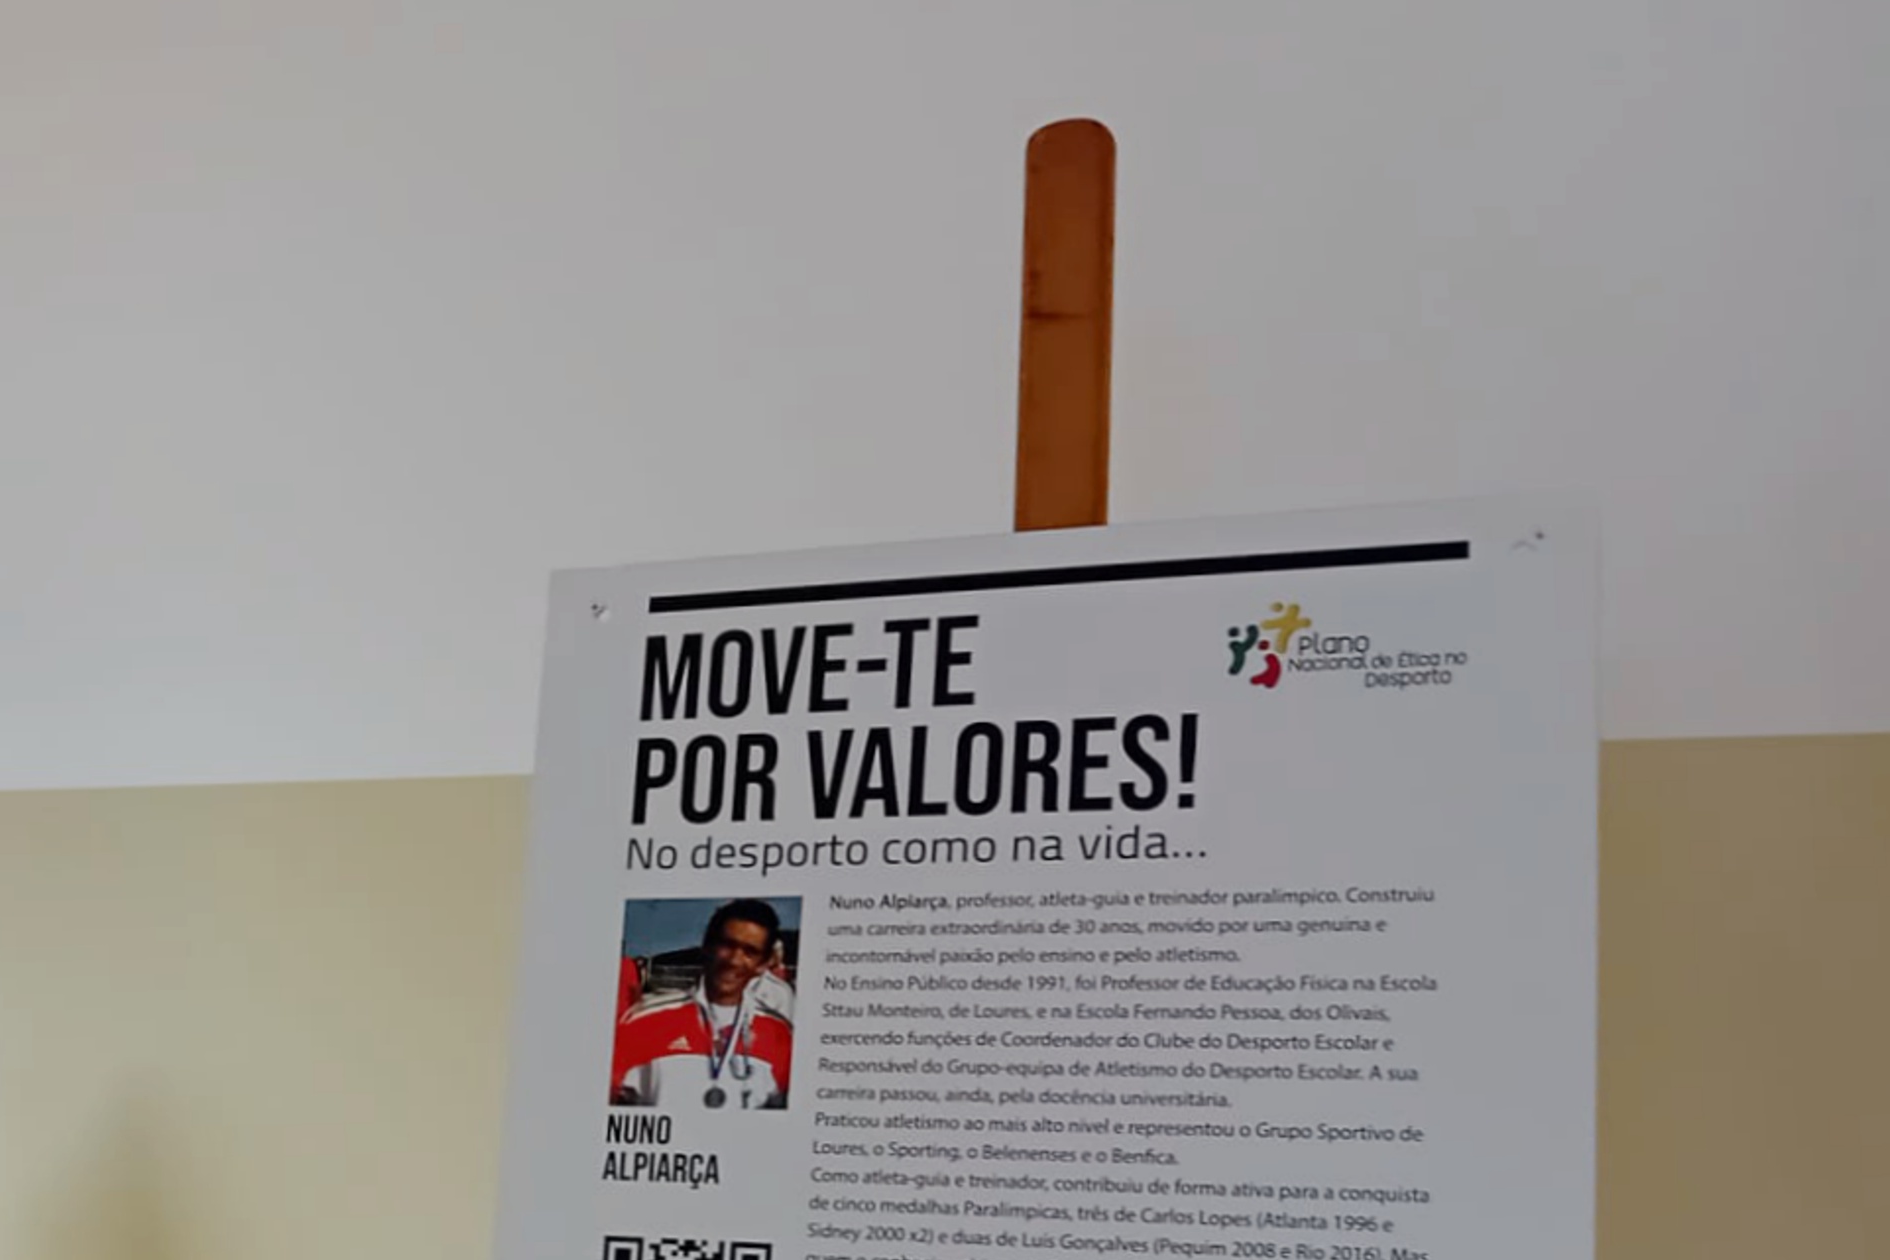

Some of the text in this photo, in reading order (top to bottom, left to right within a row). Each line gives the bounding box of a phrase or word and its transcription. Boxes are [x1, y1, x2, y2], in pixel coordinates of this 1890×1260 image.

[1298, 632, 1370, 656] Plano
[638, 613, 981, 723] MOVE-TE
[1288, 650, 1467, 672] Nacional de Ética no
[1364, 668, 1452, 690] Desporto
[630, 712, 1201, 826] POR VALORES!
[626, 823, 1207, 878] No desporto como na vida...
[828, 894, 876, 911] Nuno
[878, 892, 952, 912] Alpiarça,
[955, 892, 1035, 912] professor,
[1038, 890, 1131, 911] atleta-guia
[1133, 893, 1145, 907] e
[1148, 889, 1229, 907] treinador
[1344, 886, 1435, 904] Construiu
[823, 975, 848, 991] No
[850, 974, 905, 992] Ensino
[970, 974, 1023, 992] desde
[1074, 973, 1098, 991] foi
[1100, 973, 1180, 992] Professor
[1183, 974, 1208, 992] de
[1209, 974, 1296, 995] Educação
[1352, 978, 1376, 991] na
[1379, 974, 1439, 992] Escola
[819, 1030, 905, 1047] exercendo
[974, 1030, 998, 1048] de
[999, 1030, 1114, 1048] Coordenador
[1115, 1031, 1141, 1048] do
[1142, 1031, 1196, 1050] Clube
[1197, 1032, 1224, 1050] do
[1225, 1032, 1311, 1054] Desporto
[1314, 1033, 1379, 1052] Escolar
[1382, 1038, 1395, 1052] e
[605, 1113, 673, 1146] NUNO
[601, 1150, 720, 1191] ALPIARÇA
[809, 1166, 1430, 1206] Como atleta-guia e treinador, contribuiu de forma ativa para a conquista
